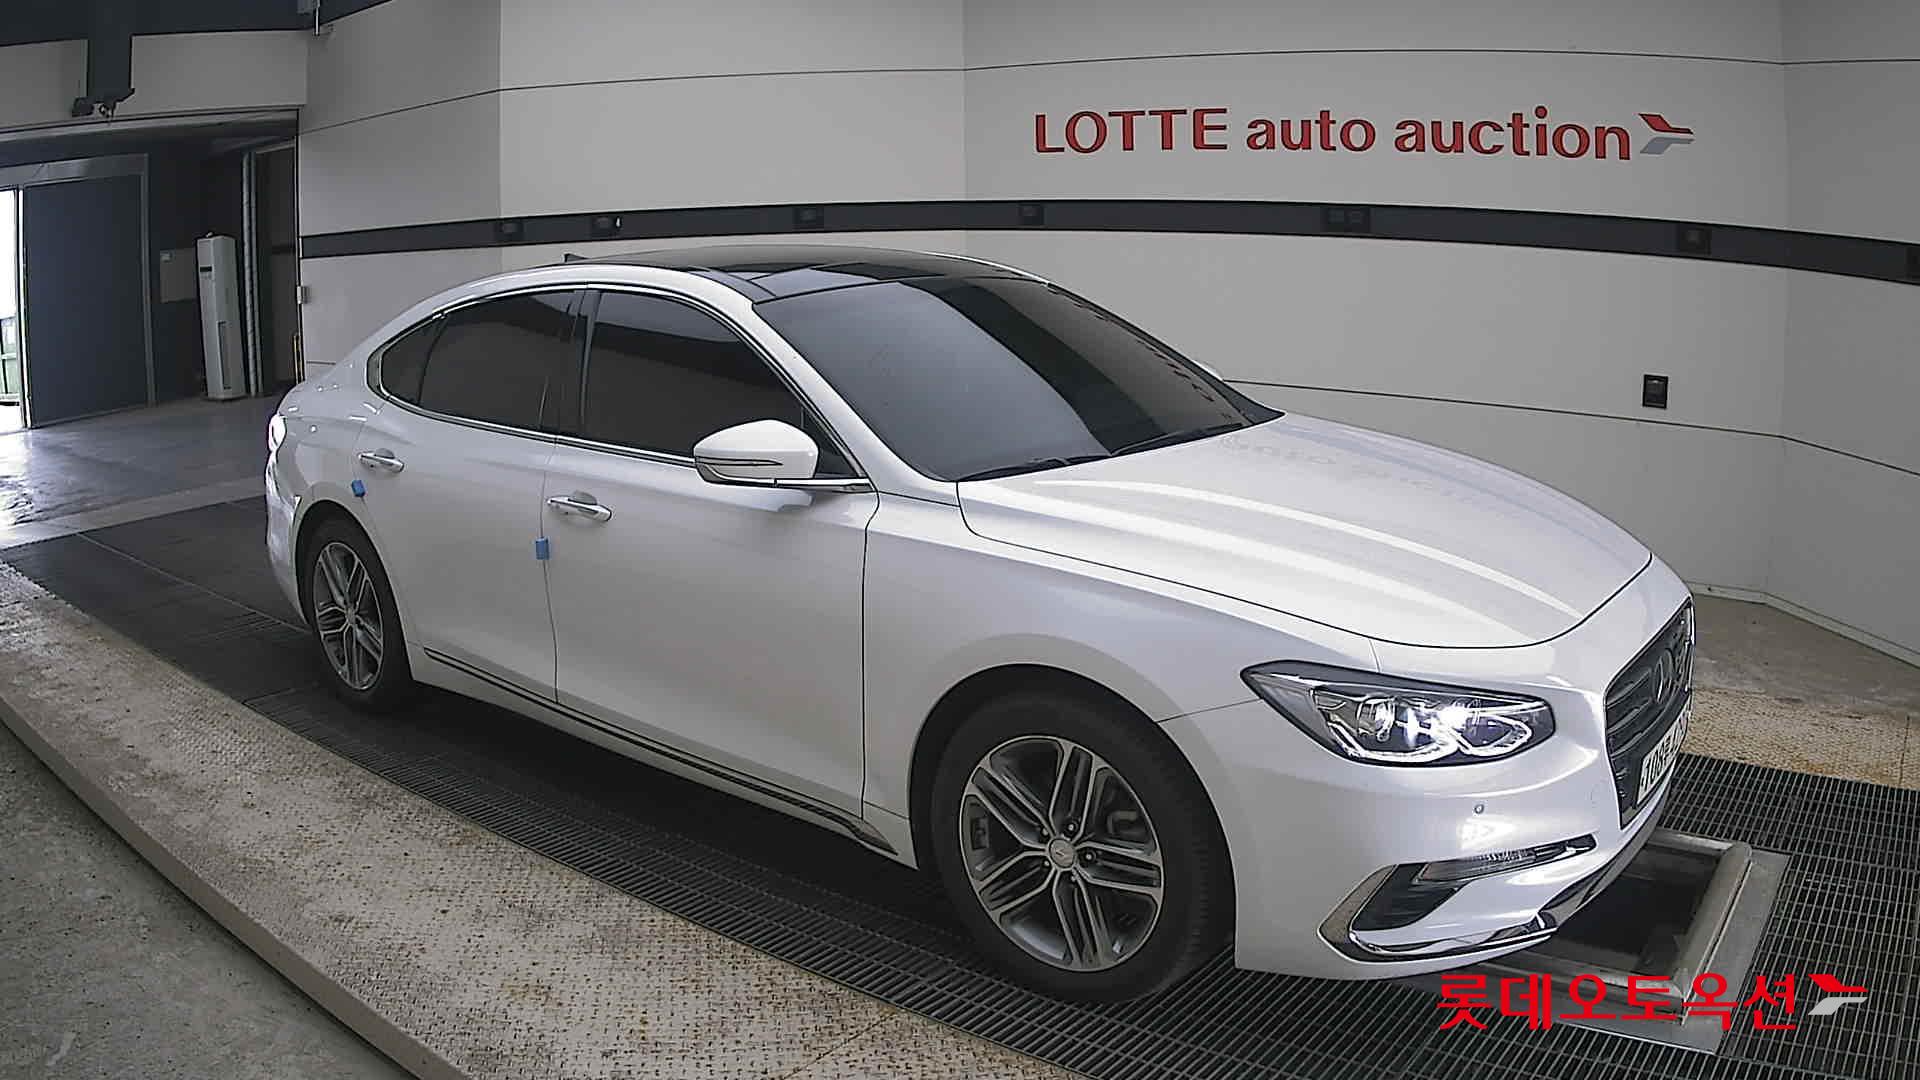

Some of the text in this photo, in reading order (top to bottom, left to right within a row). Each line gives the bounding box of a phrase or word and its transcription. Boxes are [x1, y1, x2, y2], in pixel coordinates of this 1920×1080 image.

[1034, 105, 1632, 161] LOTTE auto auction
